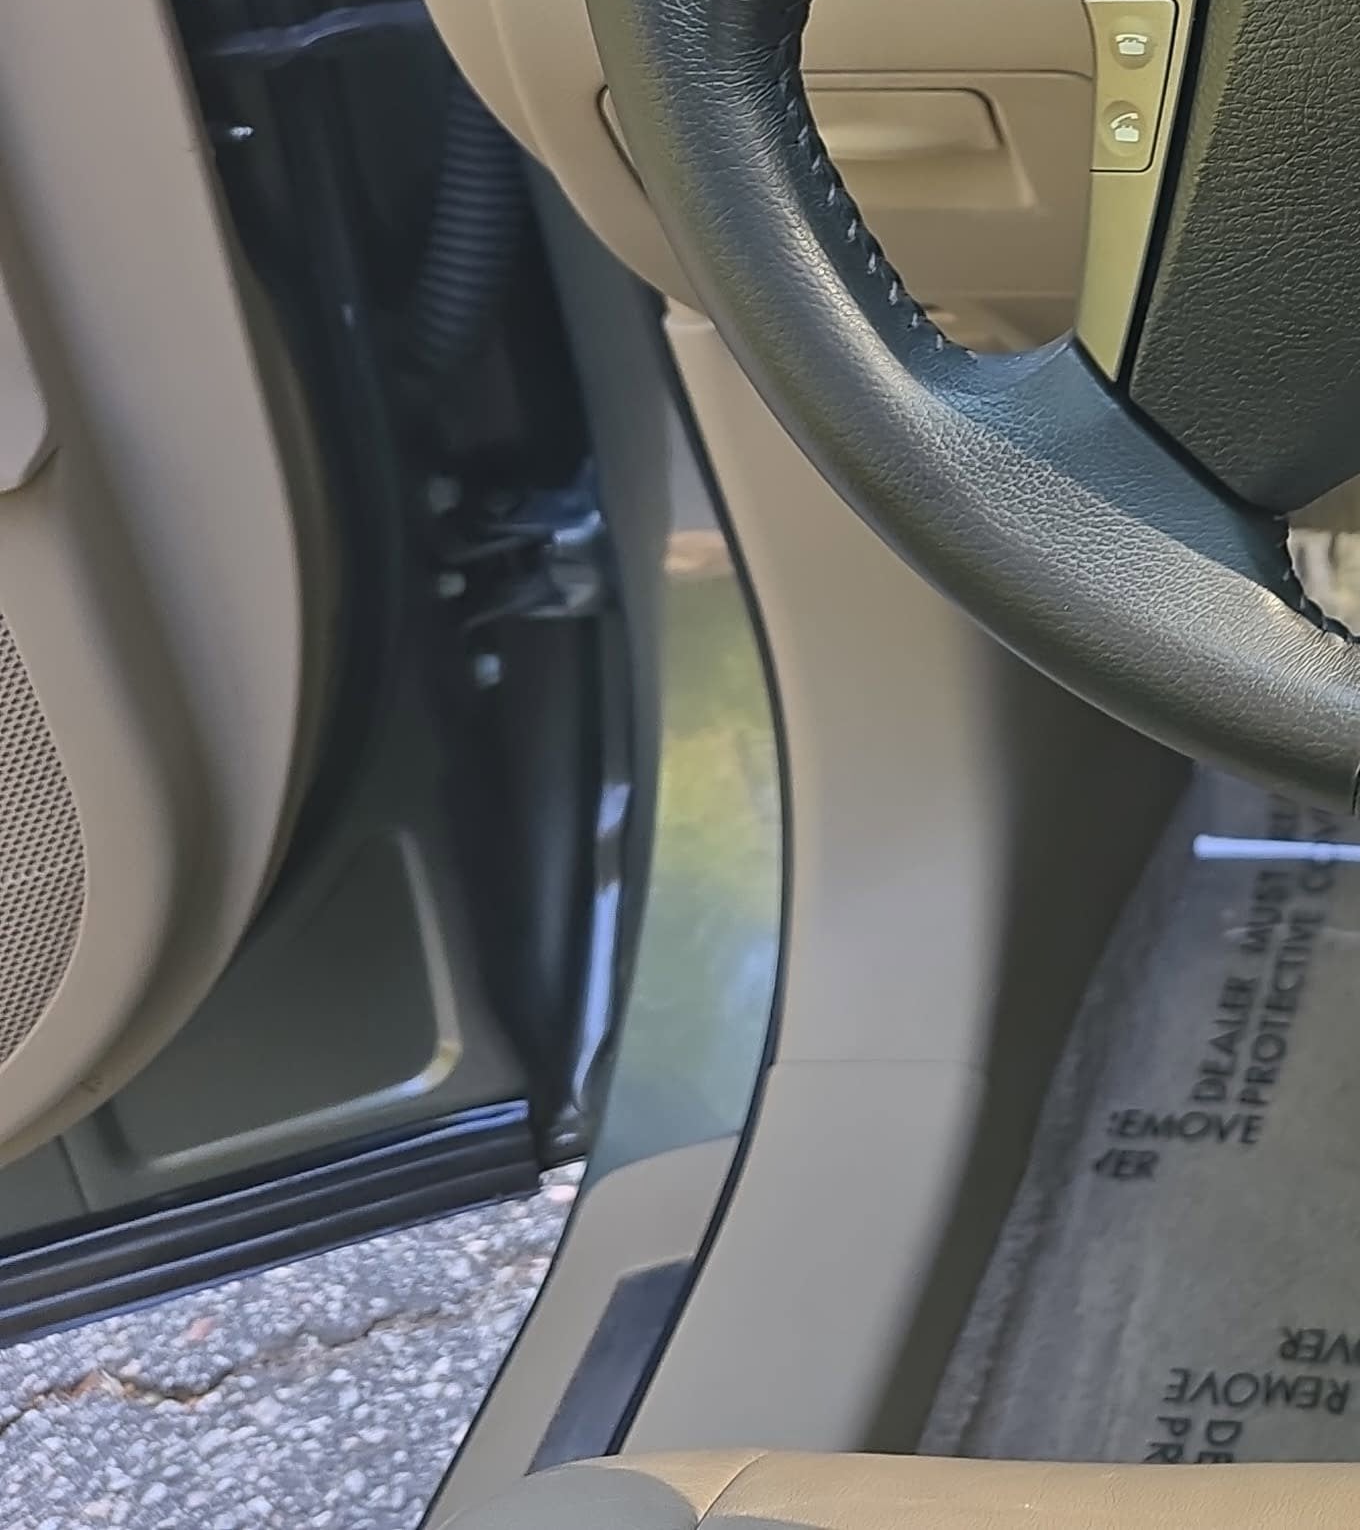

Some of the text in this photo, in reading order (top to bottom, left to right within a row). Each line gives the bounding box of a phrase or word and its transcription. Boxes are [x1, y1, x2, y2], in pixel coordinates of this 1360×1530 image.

[1194, 976, 1258, 1104] DEALER
[1242, 869, 1294, 953] MUST
[1240, 912, 1325, 1106] PROTECTIVE
[1163, 1368, 1351, 1416] REMOVE
